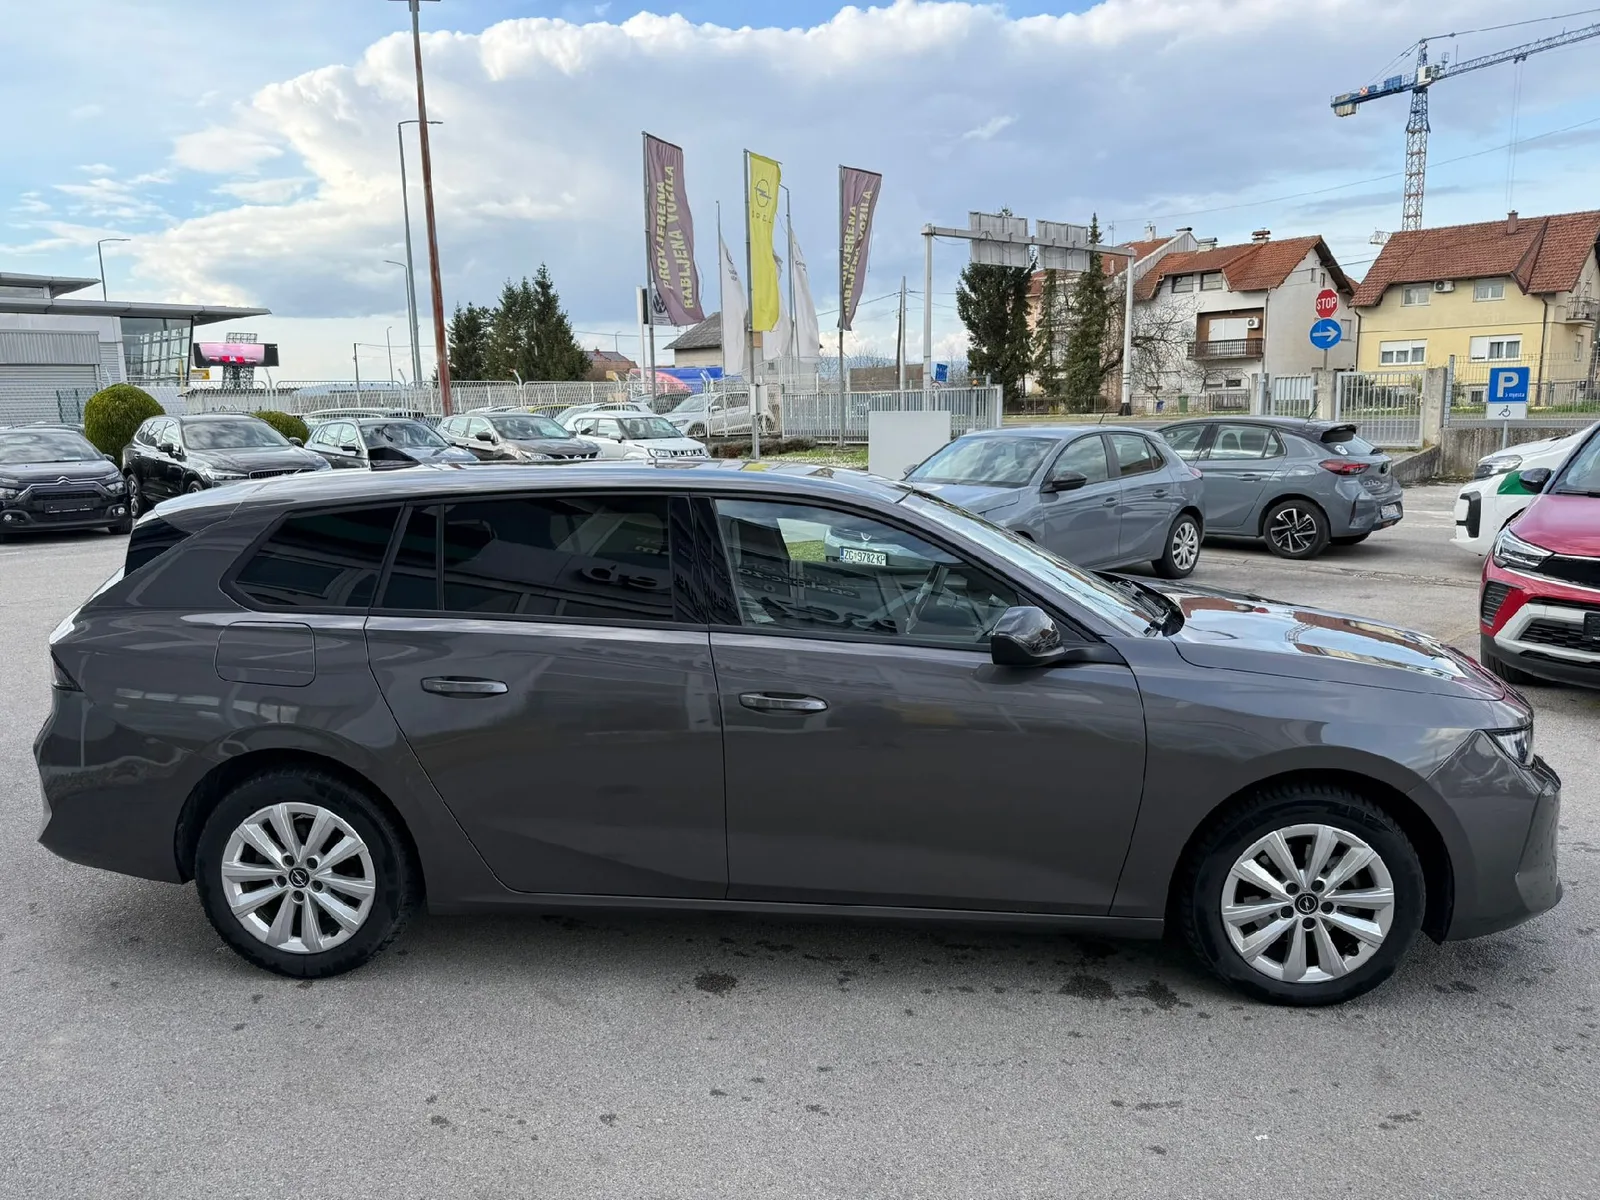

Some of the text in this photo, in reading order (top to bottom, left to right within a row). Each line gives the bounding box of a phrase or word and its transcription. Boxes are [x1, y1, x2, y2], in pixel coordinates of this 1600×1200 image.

[656, 181, 674, 290] PROVJERENA
[669, 229, 694, 309] RABLJENA
[1316, 296, 1337, 310] STOP
[1496, 371, 1519, 398] P
[844, 550, 854, 560] ZG
